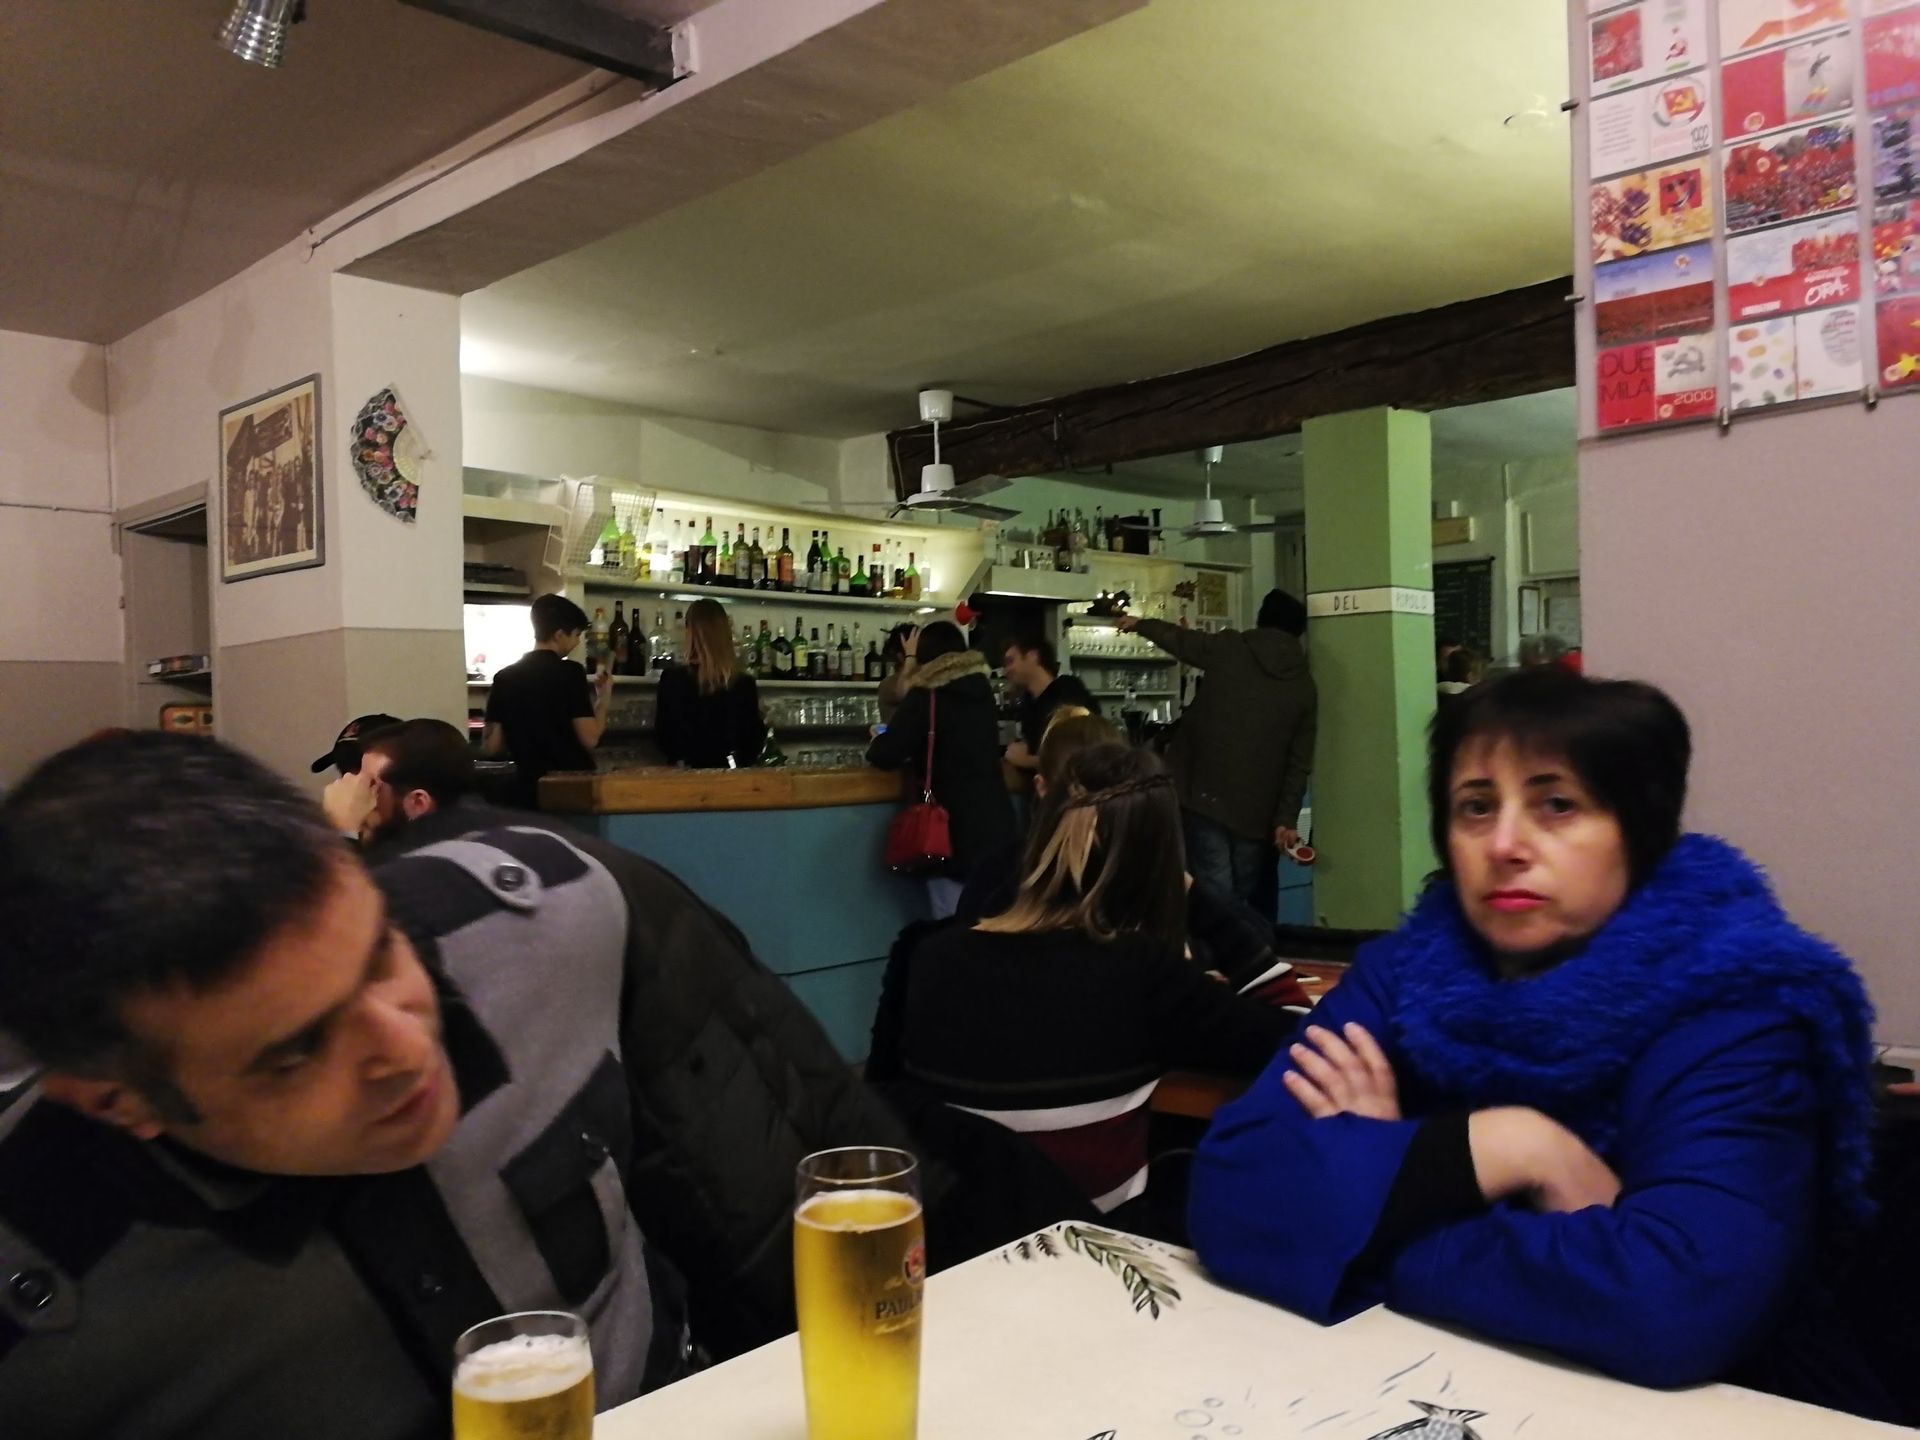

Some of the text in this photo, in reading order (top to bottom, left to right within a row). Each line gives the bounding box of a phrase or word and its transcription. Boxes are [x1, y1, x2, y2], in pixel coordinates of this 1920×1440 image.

[1600, 346, 1651, 378] DUE
[1673, 389, 1715, 405] 2000
[1333, 595, 1360, 612] DEL
